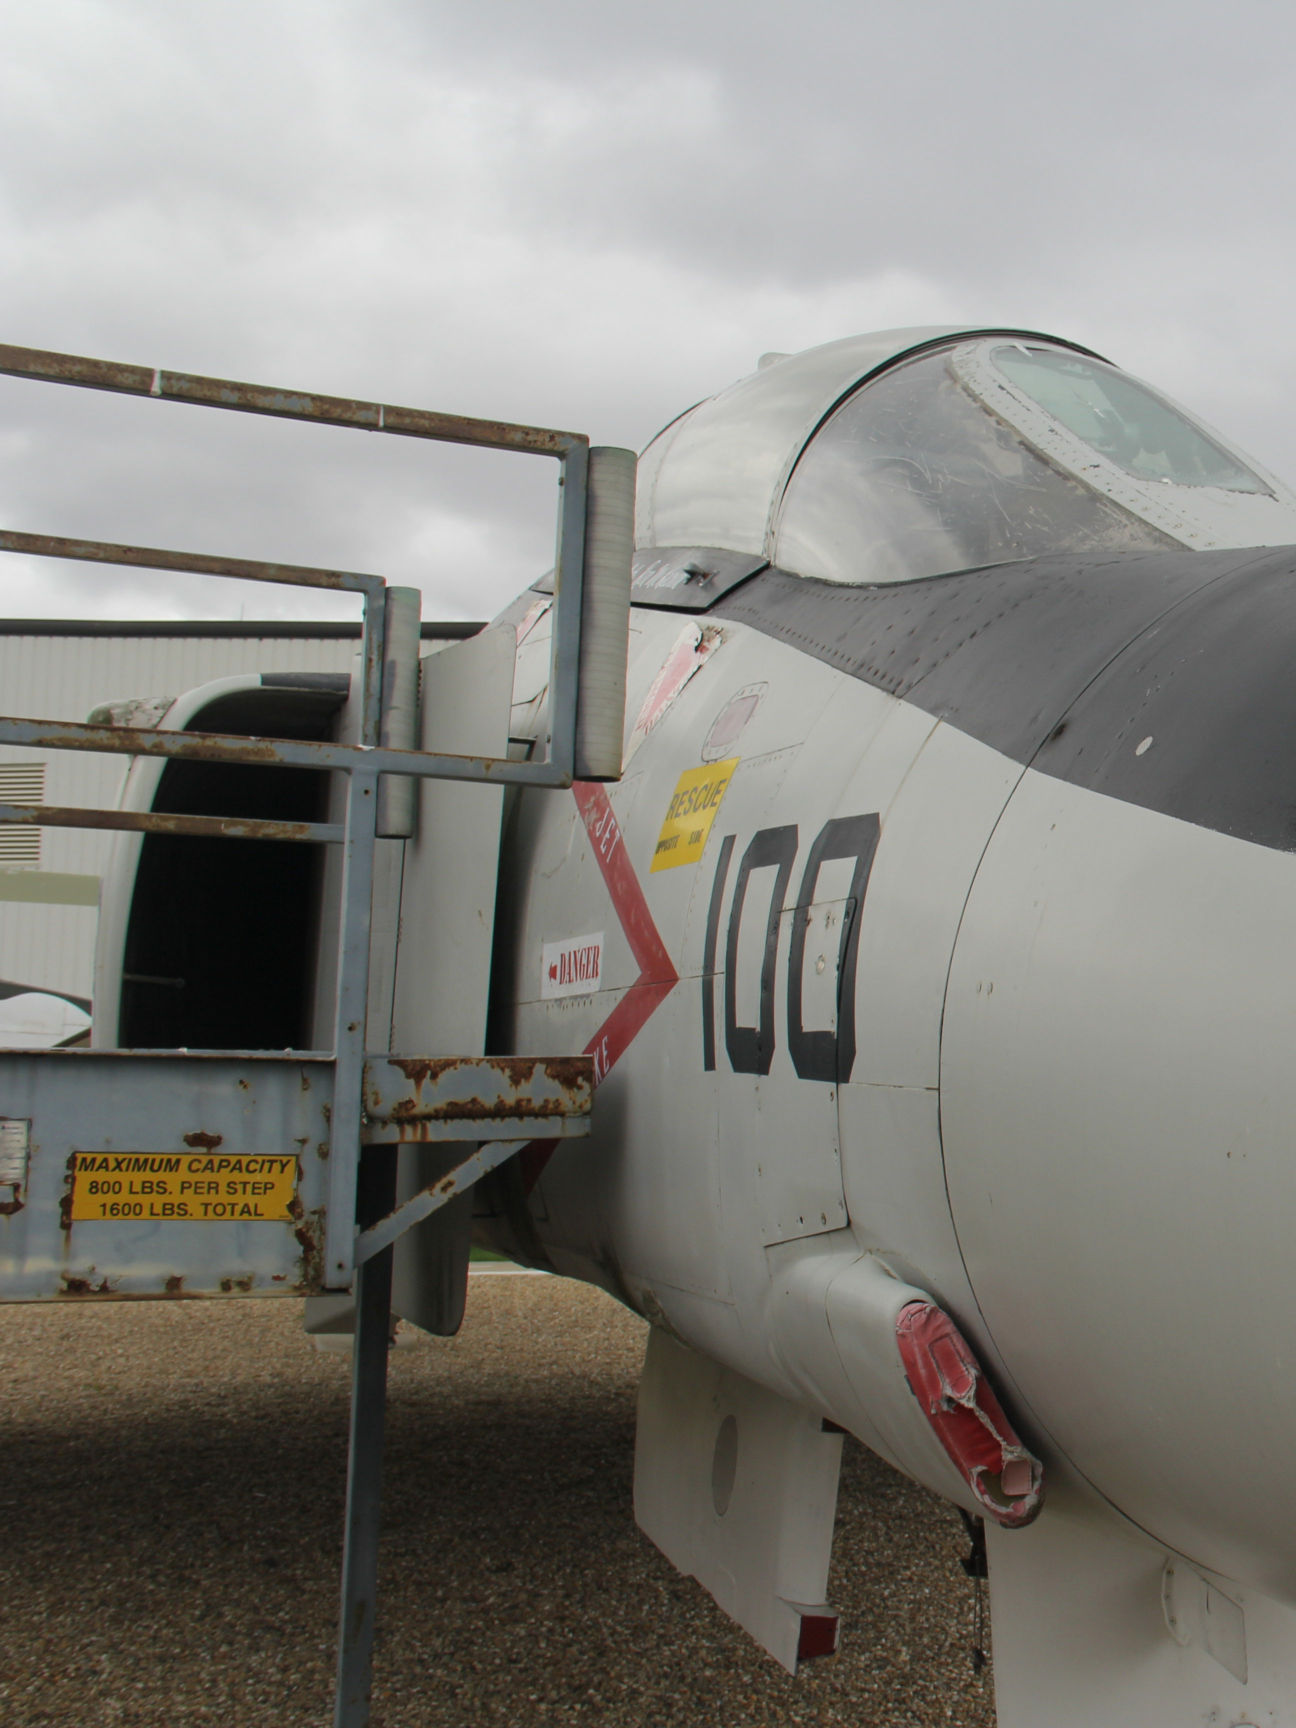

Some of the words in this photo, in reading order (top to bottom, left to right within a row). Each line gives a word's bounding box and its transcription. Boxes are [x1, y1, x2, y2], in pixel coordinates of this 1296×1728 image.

[665, 778, 728, 821] RESCUE
[596, 807, 621, 864] JET
[559, 945, 600, 985] DANGER
[701, 812, 881, 1084] 100
[77, 1156, 181, 1173] MAXIMUM
[187, 1158, 292, 1174] CAPACITY
[88, 1180, 122, 1195] 800
[128, 1180, 173, 1195] LBS.
[179, 1181, 220, 1195] PER
[225, 1181, 275, 1196] STEP
[99, 1202, 143, 1217] 1600
[149, 1202, 194, 1217] LBS.
[200, 1202, 265, 1218] TOTAL
